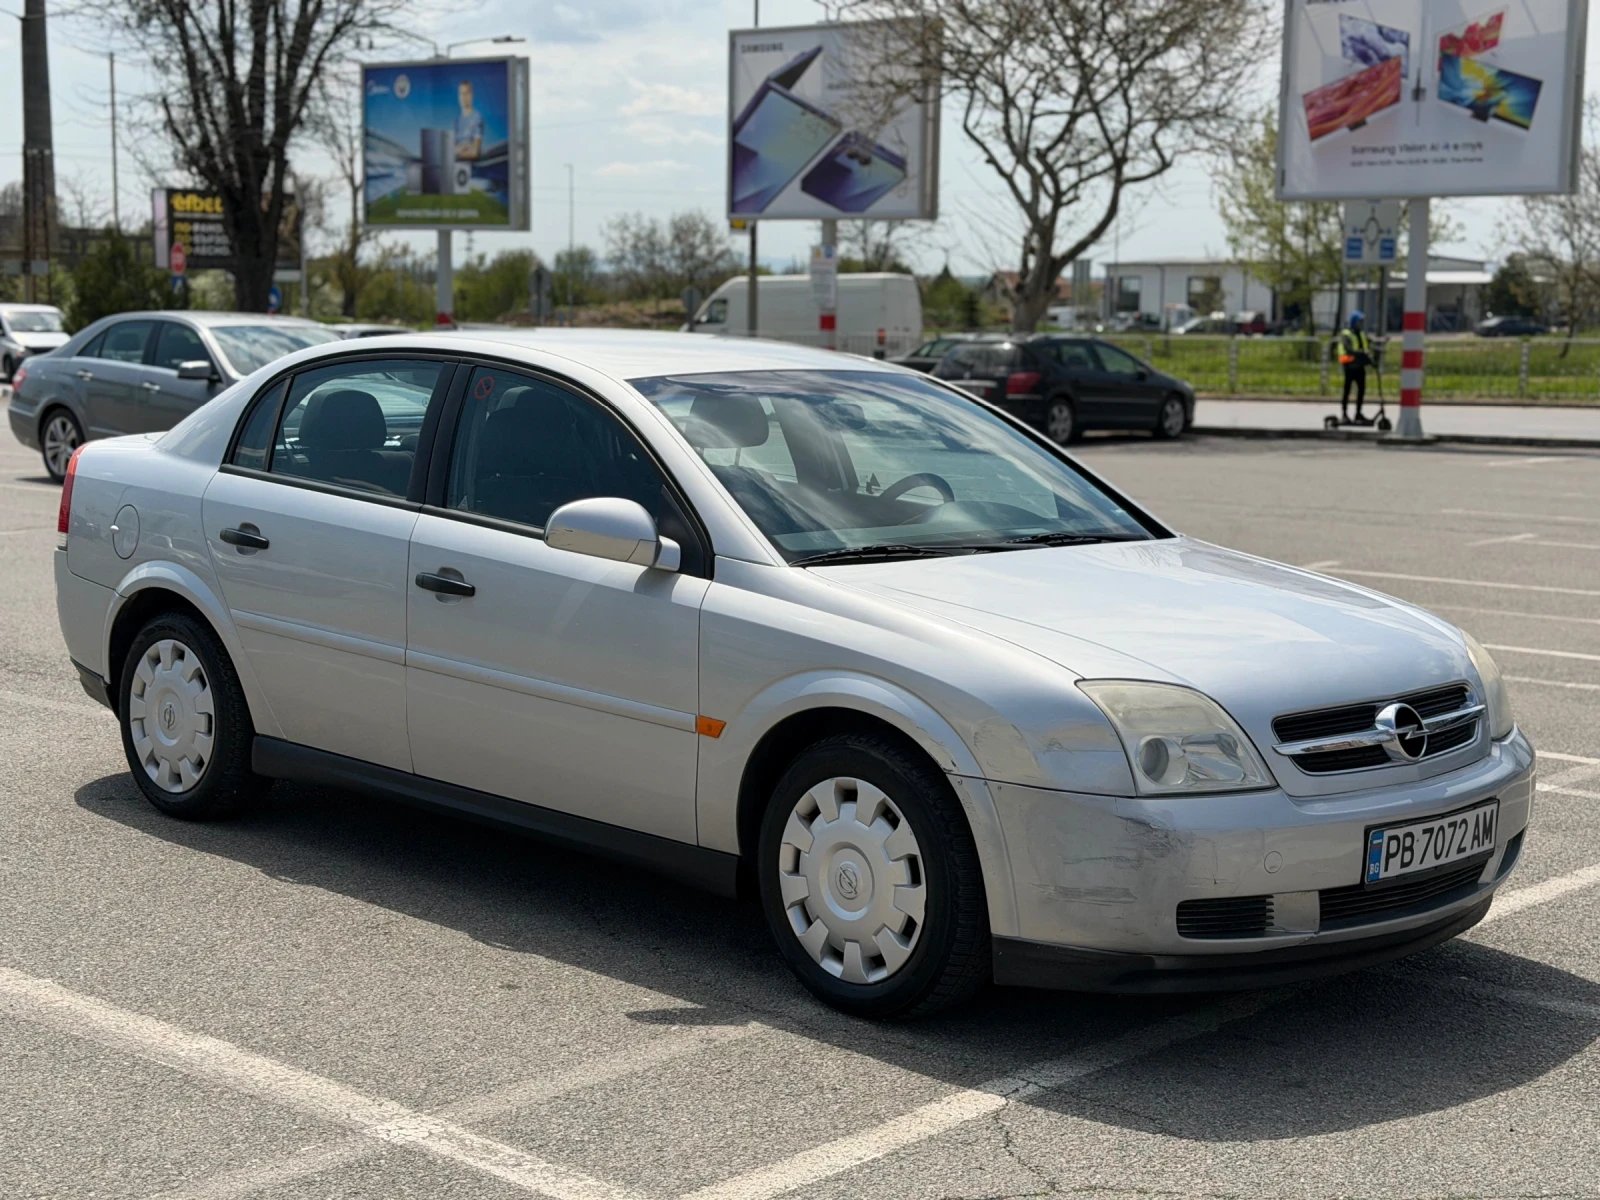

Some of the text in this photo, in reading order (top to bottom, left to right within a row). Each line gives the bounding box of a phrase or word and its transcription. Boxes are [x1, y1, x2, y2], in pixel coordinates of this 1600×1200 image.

[1351, 145, 1396, 156] Samsung
[1384, 809, 1494, 872] PB 7072 AM
[1369, 862, 1379, 875] BG
